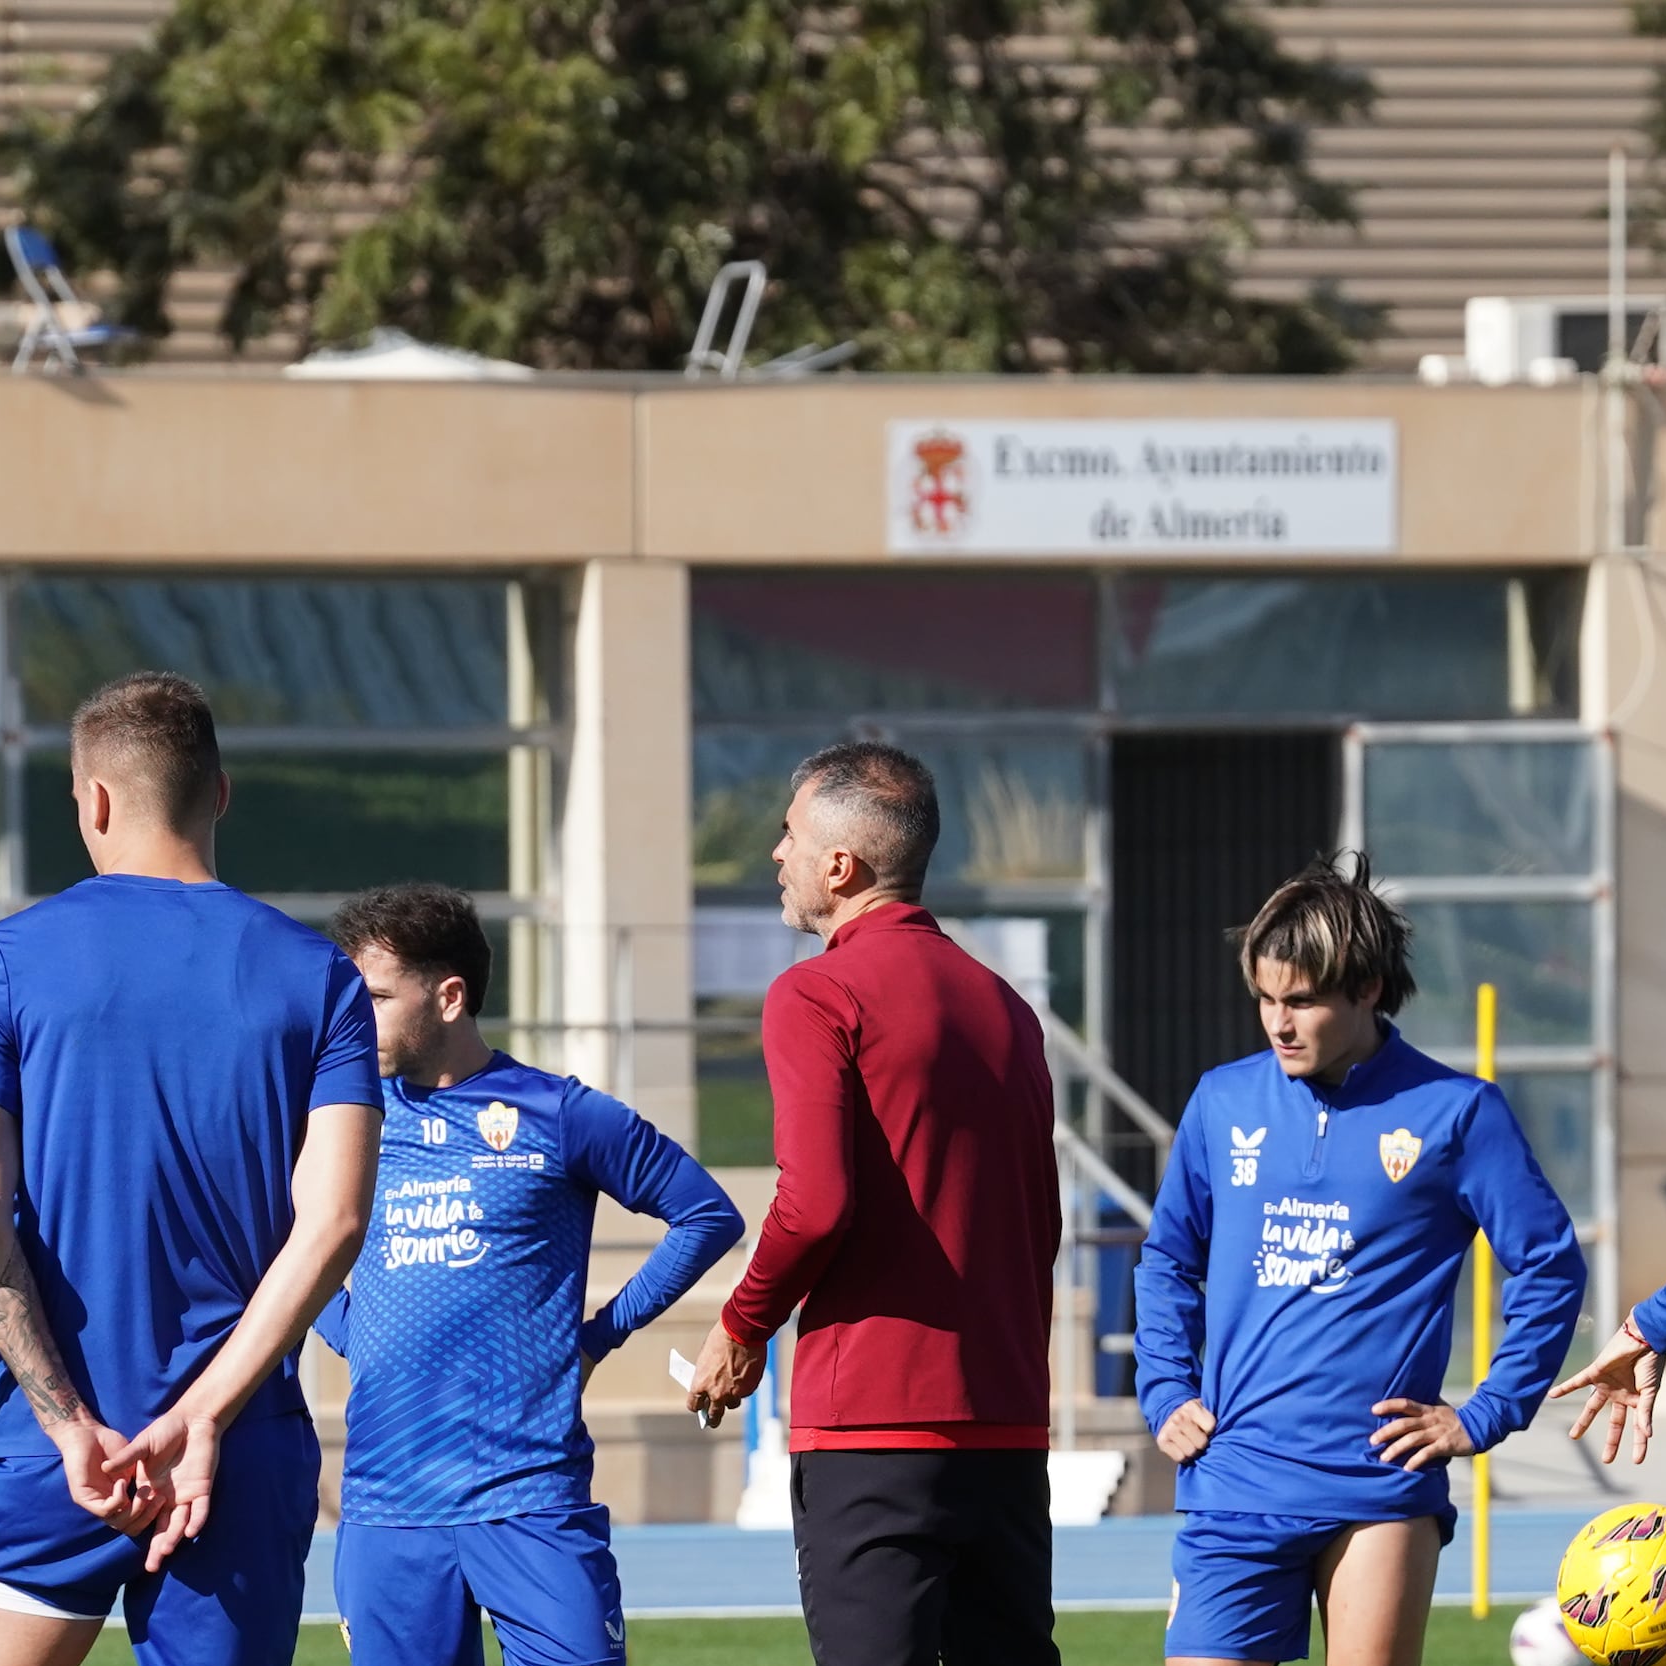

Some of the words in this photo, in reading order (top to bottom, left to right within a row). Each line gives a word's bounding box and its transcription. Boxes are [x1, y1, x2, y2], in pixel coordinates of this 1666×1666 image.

[994, 434, 1127, 477] Excmo.
[1141, 434, 1383, 490] Ayuntamiento
[1091, 500, 1130, 540] de
[1141, 496, 1287, 540] Almería
[420, 1118, 447, 1145] 10
[384, 1188, 399, 1201] En
[399, 1174, 472, 1198] Almería
[1231, 1157, 1258, 1187] 38
[385, 1203, 404, 1226] la
[405, 1194, 465, 1230] vida
[466, 1200, 484, 1221] te
[1263, 1201, 1278, 1215] En
[1277, 1196, 1350, 1221] Almería
[1261, 1217, 1282, 1243] la
[1282, 1218, 1340, 1255] vida
[1340, 1228, 1356, 1250] te
